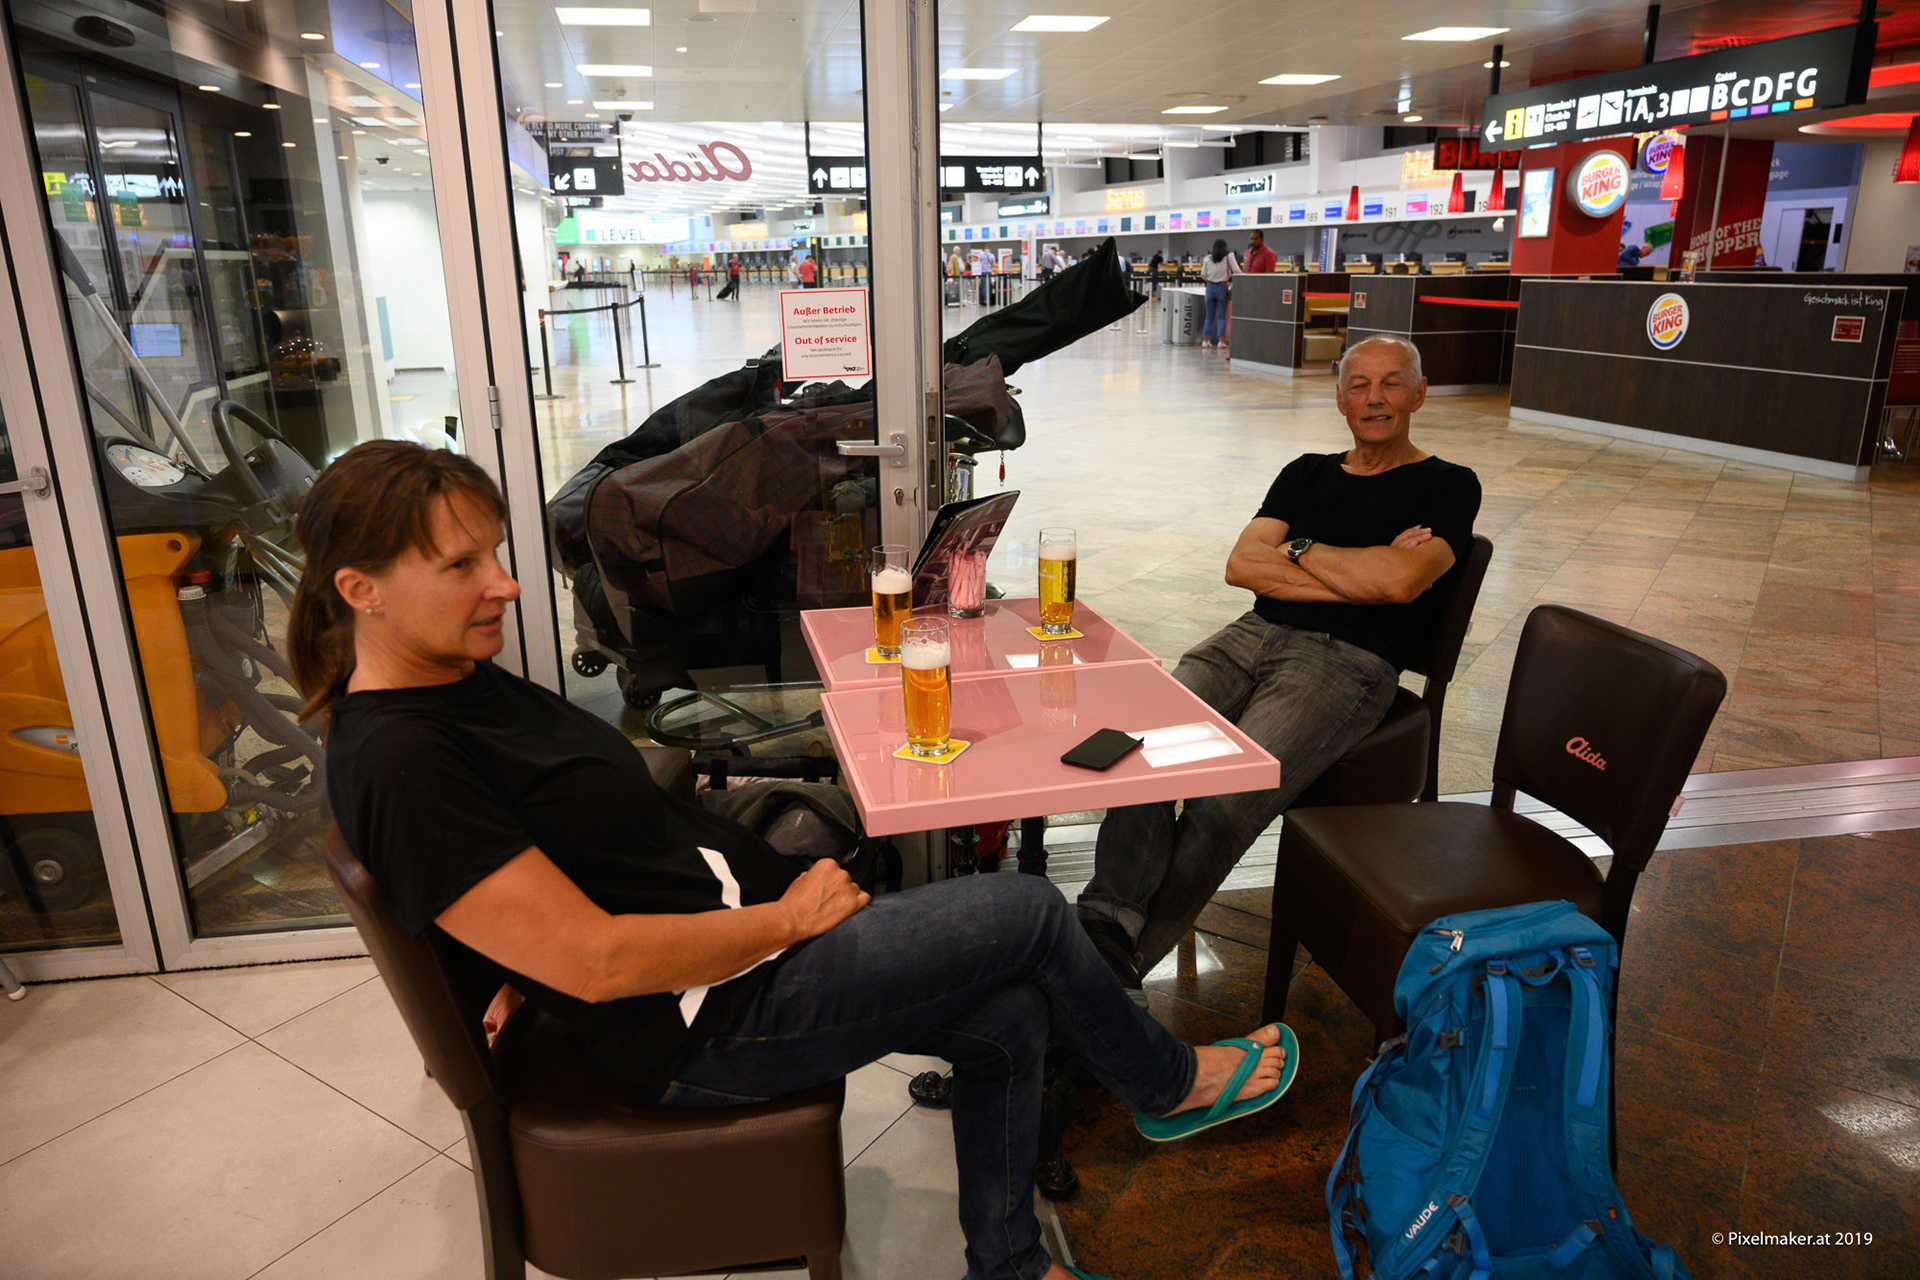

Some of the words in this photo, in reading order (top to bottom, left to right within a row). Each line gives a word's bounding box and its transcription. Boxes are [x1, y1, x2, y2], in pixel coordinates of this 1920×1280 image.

[1715, 71, 1737, 82] Gates
[1224, 178, 1266, 196] Terminal
[1267, 174, 1273, 192] 1
[1581, 165, 1621, 186] BURGER
[1582, 175, 1622, 201] KING
[1385, 207, 1397, 218] 191
[1430, 204, 1443, 215] 192
[1478, 200, 1488, 212] 19
[1306, 211, 1318, 223] 189
[601, 228, 647, 241] LEVEL
[1716, 225, 1731, 240] OF
[1733, 217, 1761, 235] THE
[793, 307, 820, 316] Außer
[823, 305, 856, 314] Betrieb
[1803, 292, 1850, 306] Geschmack
[1850, 291, 1863, 307] ist
[1864, 294, 1884, 311] King
[1183, 303, 1192, 336] Abfall
[1652, 304, 1683, 323] BURGER
[1652, 314, 1684, 337] KING
[794, 337, 812, 345] Out
[814, 336, 823, 345] of
[825, 335, 857, 344] service
[1405, 1200, 1439, 1239] VAUDE
